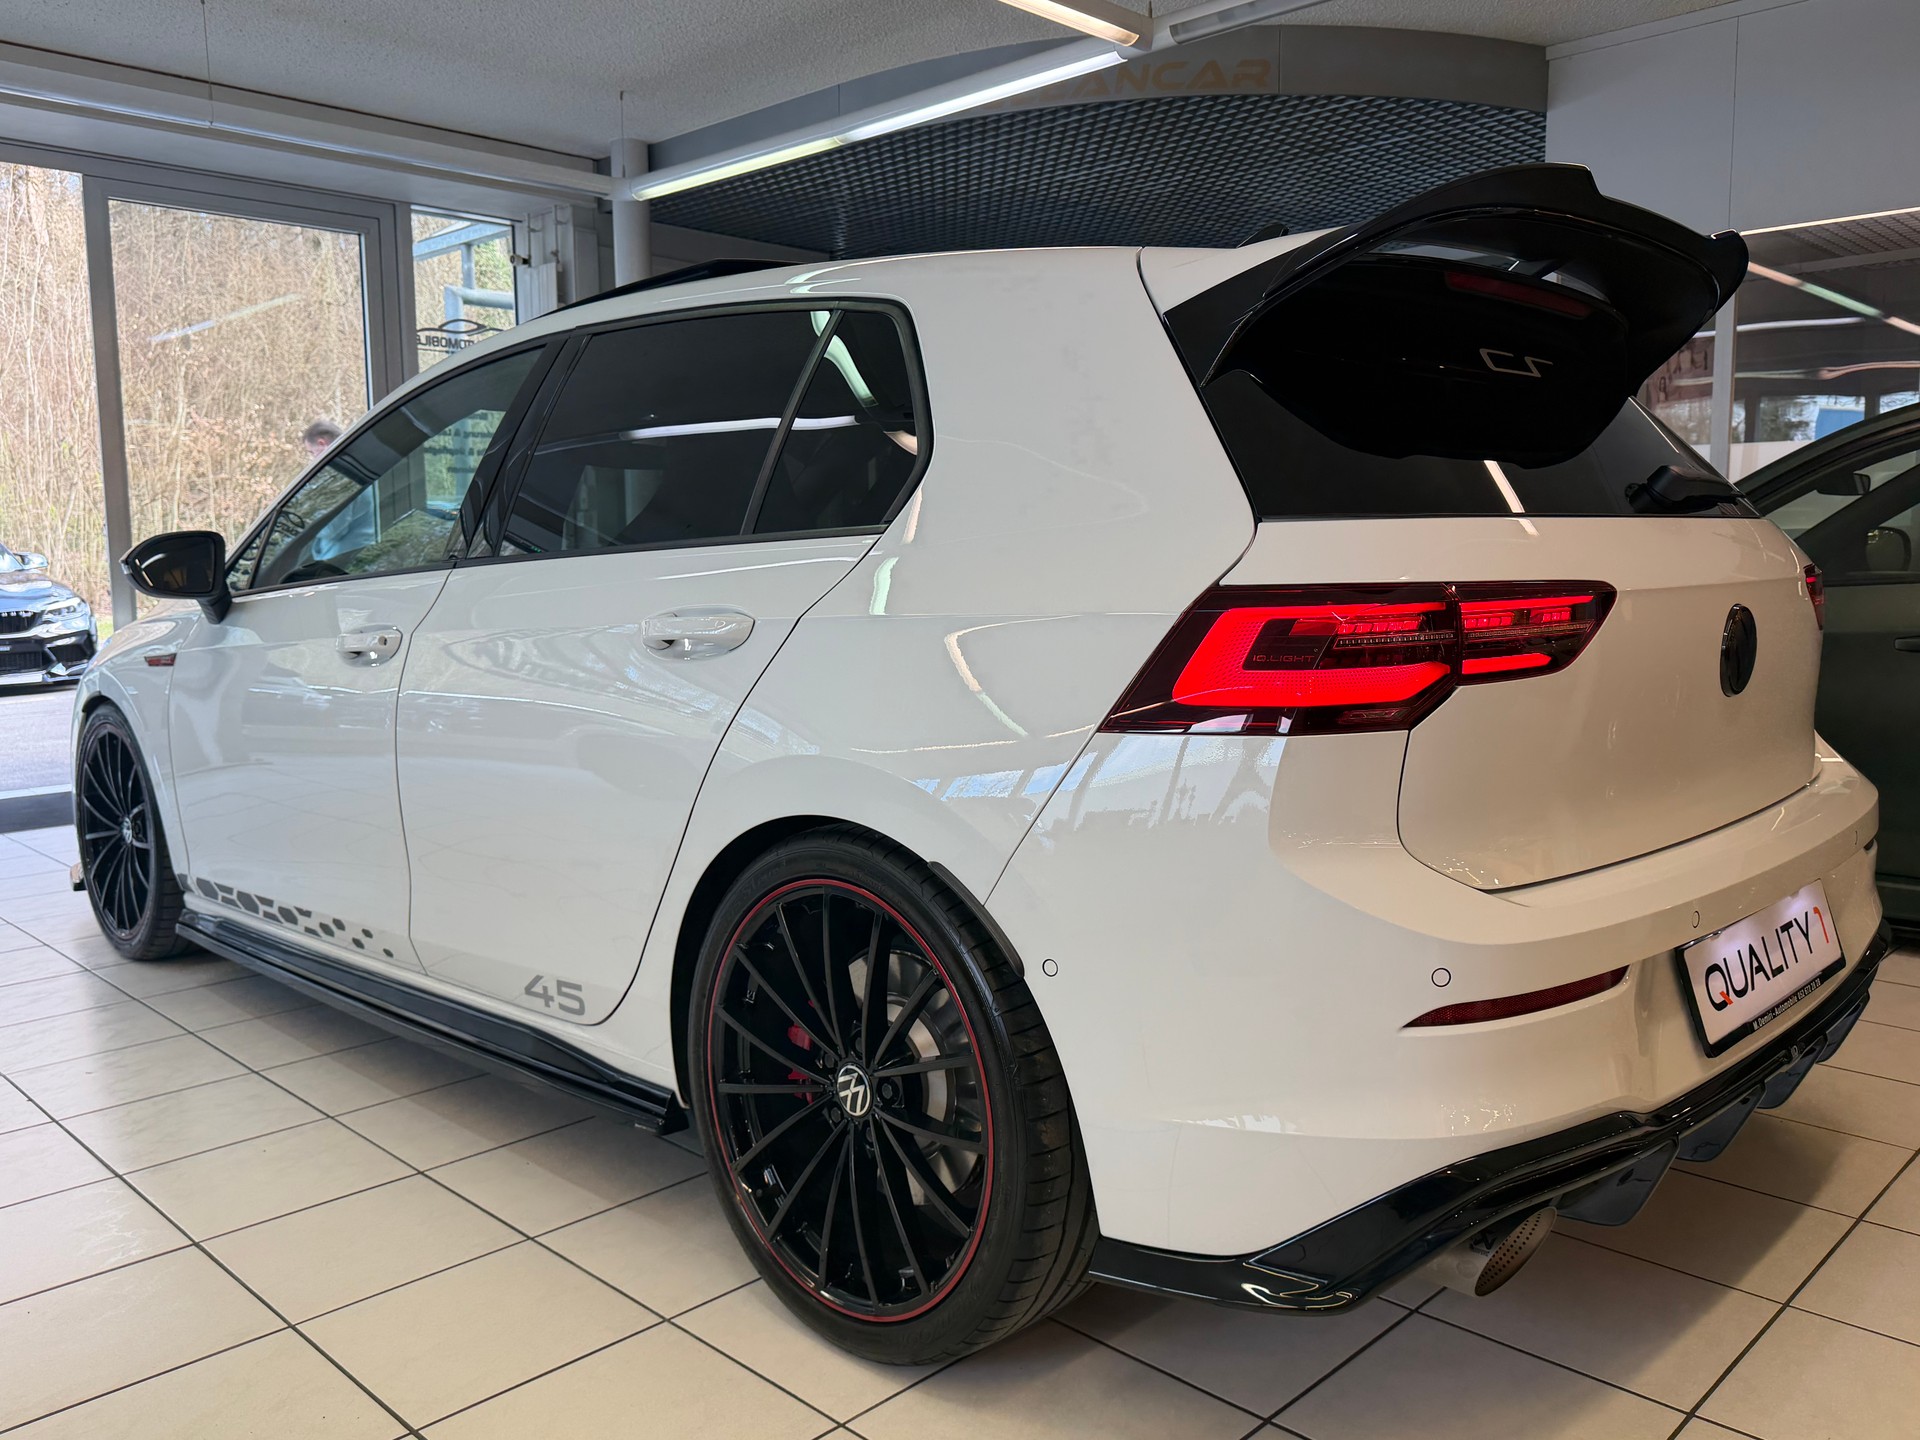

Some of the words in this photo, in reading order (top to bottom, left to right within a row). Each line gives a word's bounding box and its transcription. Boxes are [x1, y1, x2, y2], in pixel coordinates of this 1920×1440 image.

[524, 974, 586, 1016] 45
[1705, 911, 1813, 1012] QUALITY
[1813, 906, 1830, 944] 1
